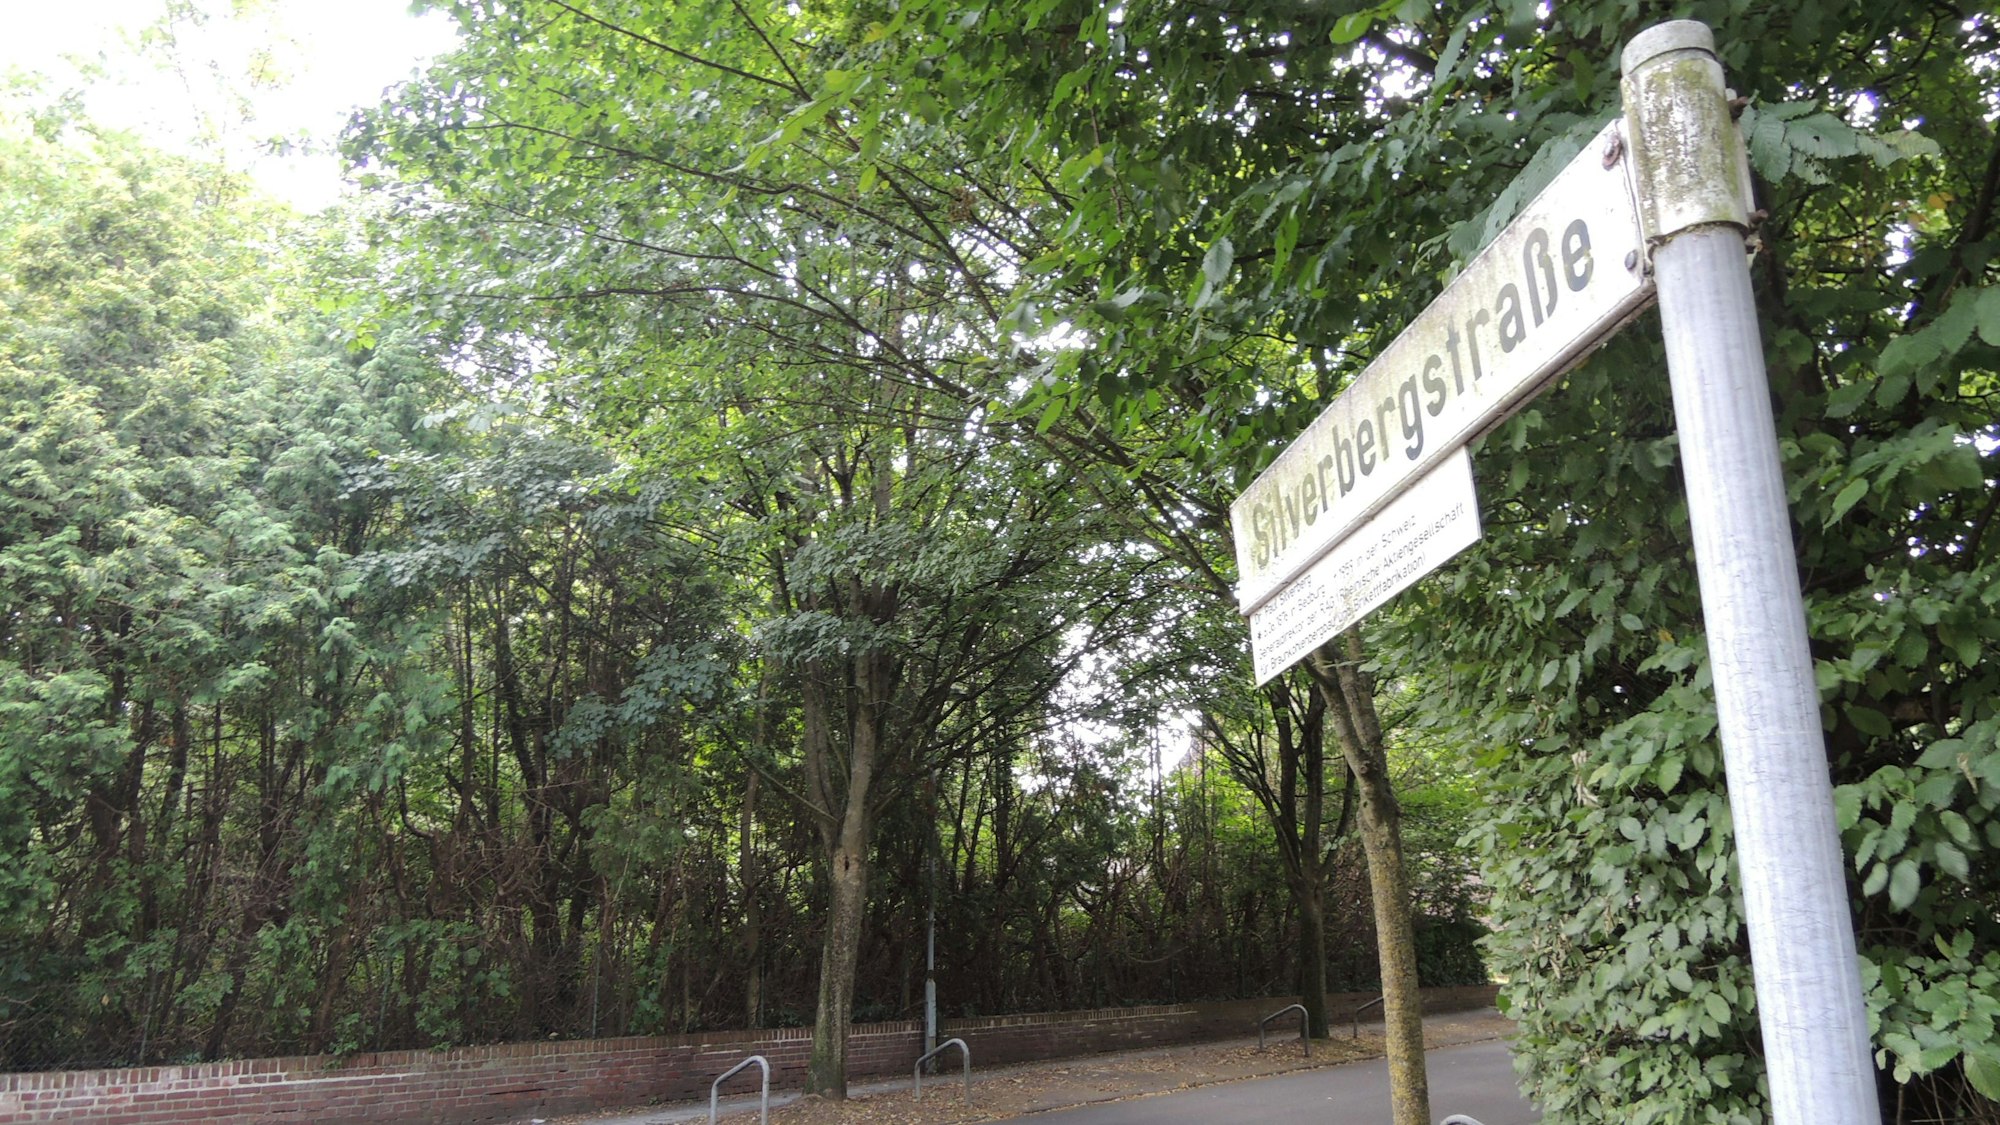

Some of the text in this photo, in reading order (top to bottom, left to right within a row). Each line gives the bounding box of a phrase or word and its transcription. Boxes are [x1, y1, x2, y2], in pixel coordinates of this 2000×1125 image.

[1251, 218, 1595, 570] Silverbergstraße
[1381, 514, 1416, 549] Schweiz
[1383, 502, 1464, 569] Aktiengesellschaft
